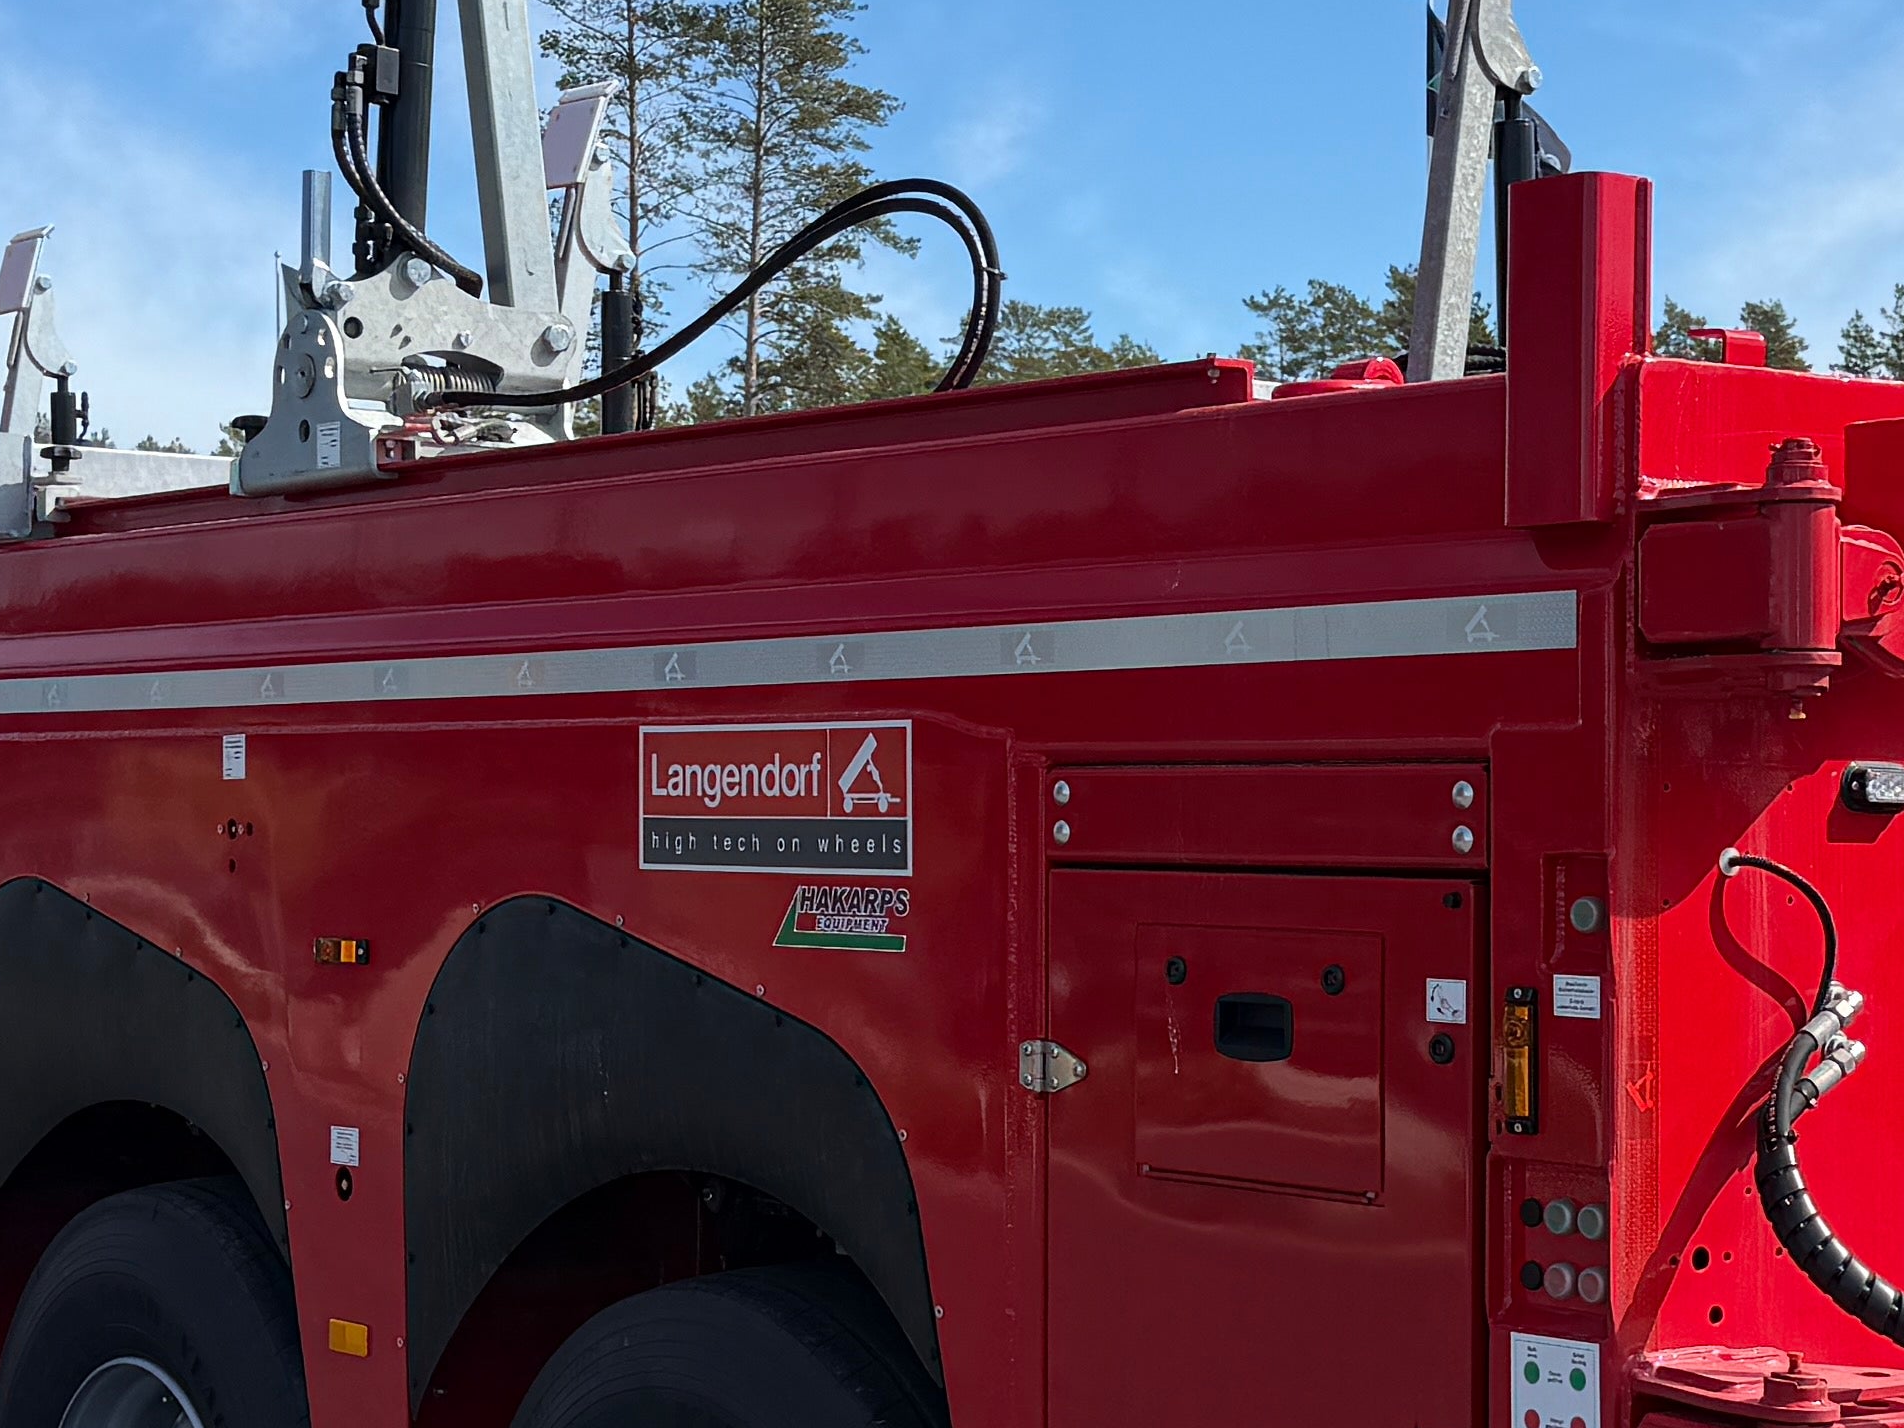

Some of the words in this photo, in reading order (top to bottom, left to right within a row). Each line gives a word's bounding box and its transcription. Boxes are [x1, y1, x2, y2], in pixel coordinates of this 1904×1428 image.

[651, 752, 822, 808] Langendorf
[652, 831, 696, 855] high
[713, 834, 760, 852] tech
[777, 836, 800, 853] on
[818, 834, 902, 854] wheels
[798, 885, 910, 917] HAKARPS
[816, 915, 889, 933] EQUIPMENT
